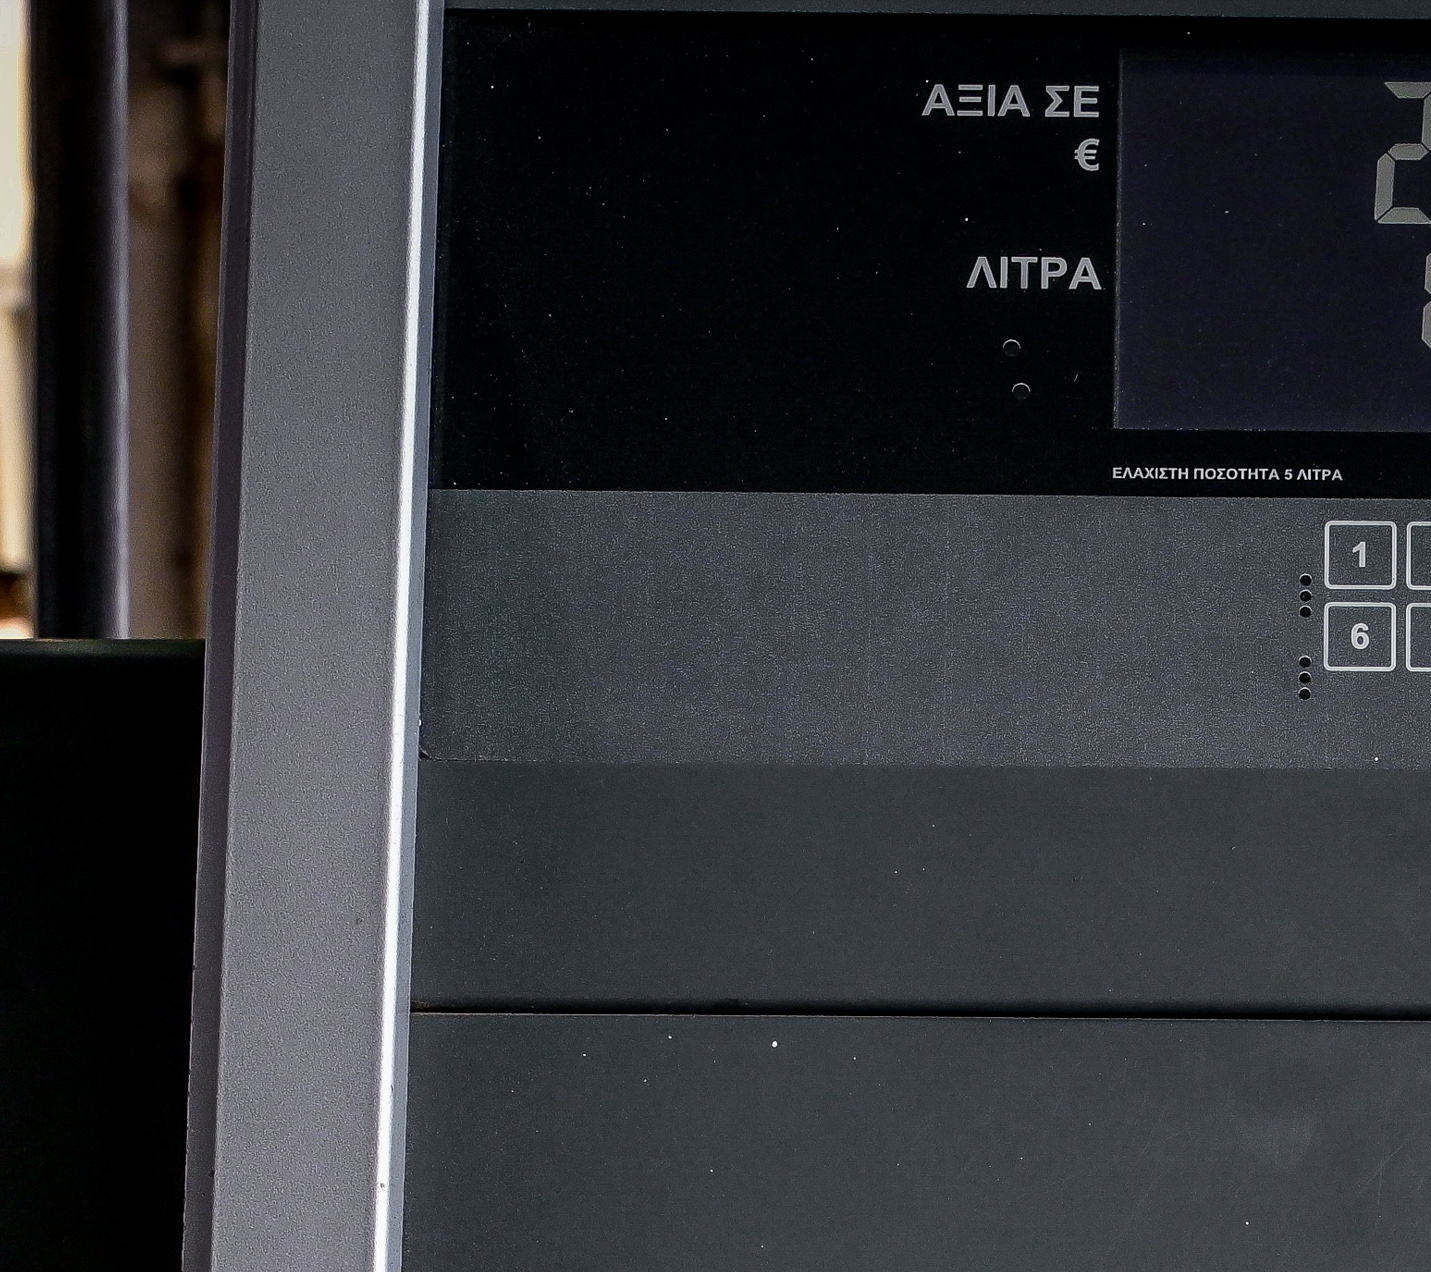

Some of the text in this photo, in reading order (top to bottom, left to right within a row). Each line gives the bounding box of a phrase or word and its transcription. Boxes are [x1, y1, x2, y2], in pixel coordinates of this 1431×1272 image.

[921, 84, 1101, 119] ΑΞΙΑ ΣΕ
[1074, 137, 1101, 172] €
[966, 256, 1102, 290] ΛΙΤΡΑ
[1112, 466, 1343, 482] ΕΛΑΧΙΣΤΗ ΠΟΣΟΤΗΤΑ 5 ΛΙΤΡΑ
[1352, 541, 1367, 568] 1
[1350, 623, 1369, 650] 6
